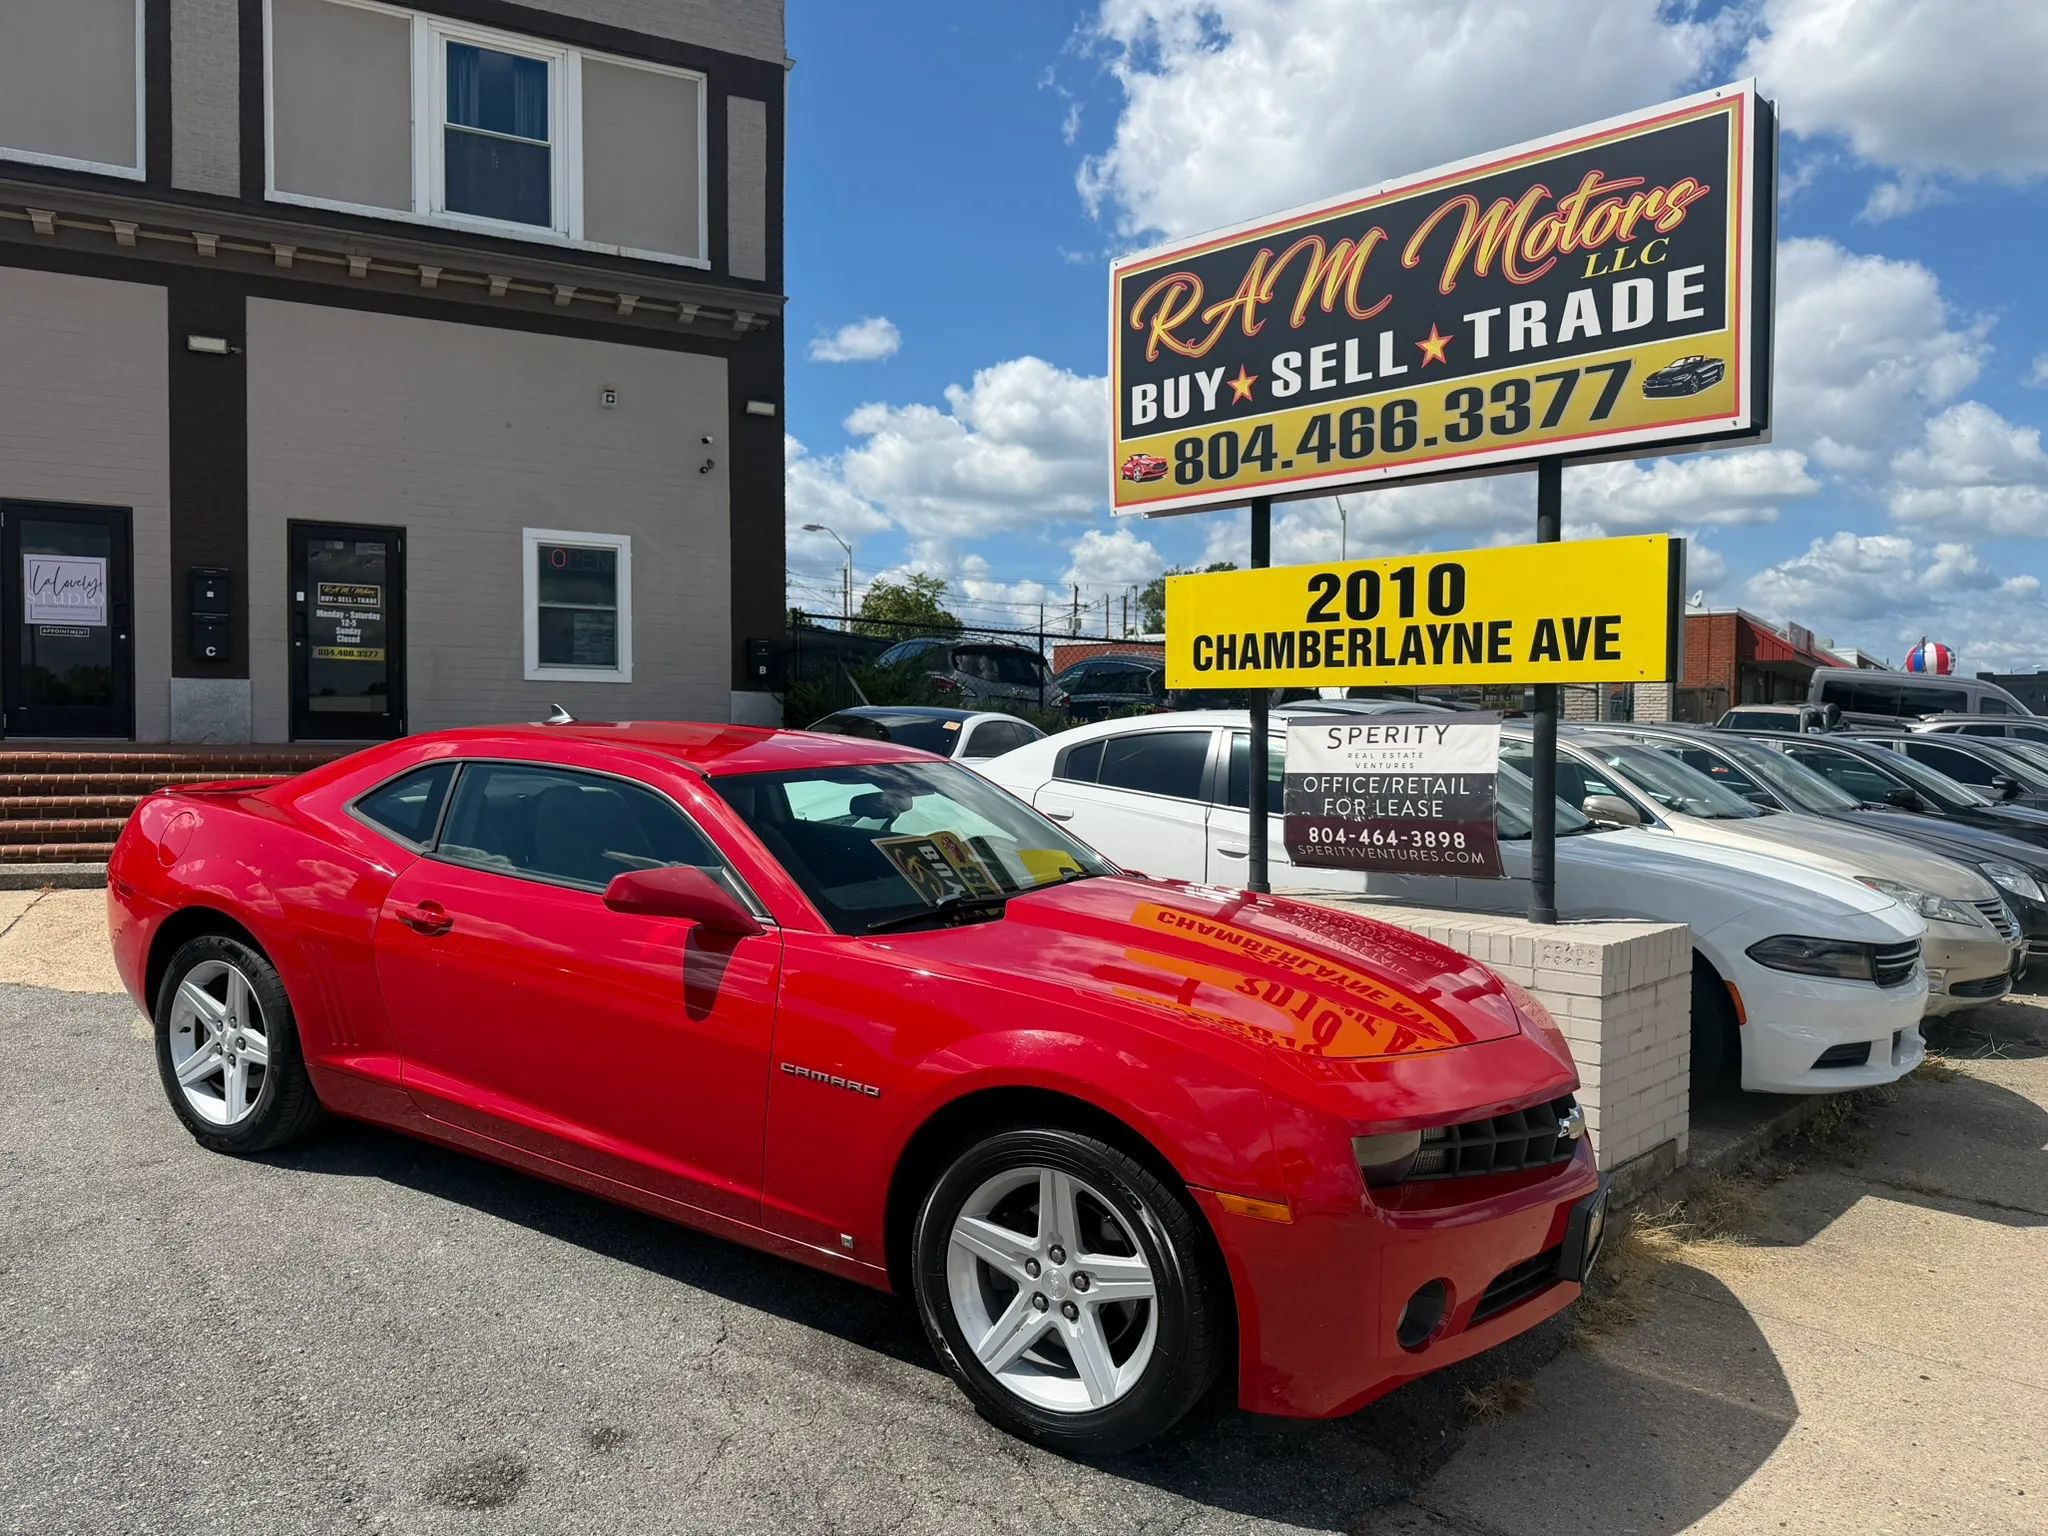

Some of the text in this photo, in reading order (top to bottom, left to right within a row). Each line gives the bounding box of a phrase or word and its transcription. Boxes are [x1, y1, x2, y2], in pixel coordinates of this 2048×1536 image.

[1130, 170, 1710, 362] RAM Motors
[1580, 237, 1672, 279] LLC
[1132, 264, 1705, 426] BUY SELL TRADE
[1174, 358, 1634, 486] 804.466.3377
[26, 591, 105, 606] STUDIO
[1305, 562, 1467, 624] 2010
[316, 609, 344, 619] Monday
[350, 611, 381, 620] Saturday
[336, 627, 361, 636] Sunday
[336, 635, 361, 643] Closed
[205, 646, 216, 657] C
[1192, 614, 1622, 672] CHAMBERLAYNE AVE
[759, 666, 767, 675] B
[1327, 724, 1449, 750] SPERITY
[1303, 776, 1470, 795] OFFICE/RETAIL
[1323, 798, 1443, 817] FOR LEASE
[1308, 827, 1466, 849] 804-464-3898
[1297, 844, 1485, 864] SPERITYVENTURES.COM
[780, 1062, 881, 1098] CAMARO
